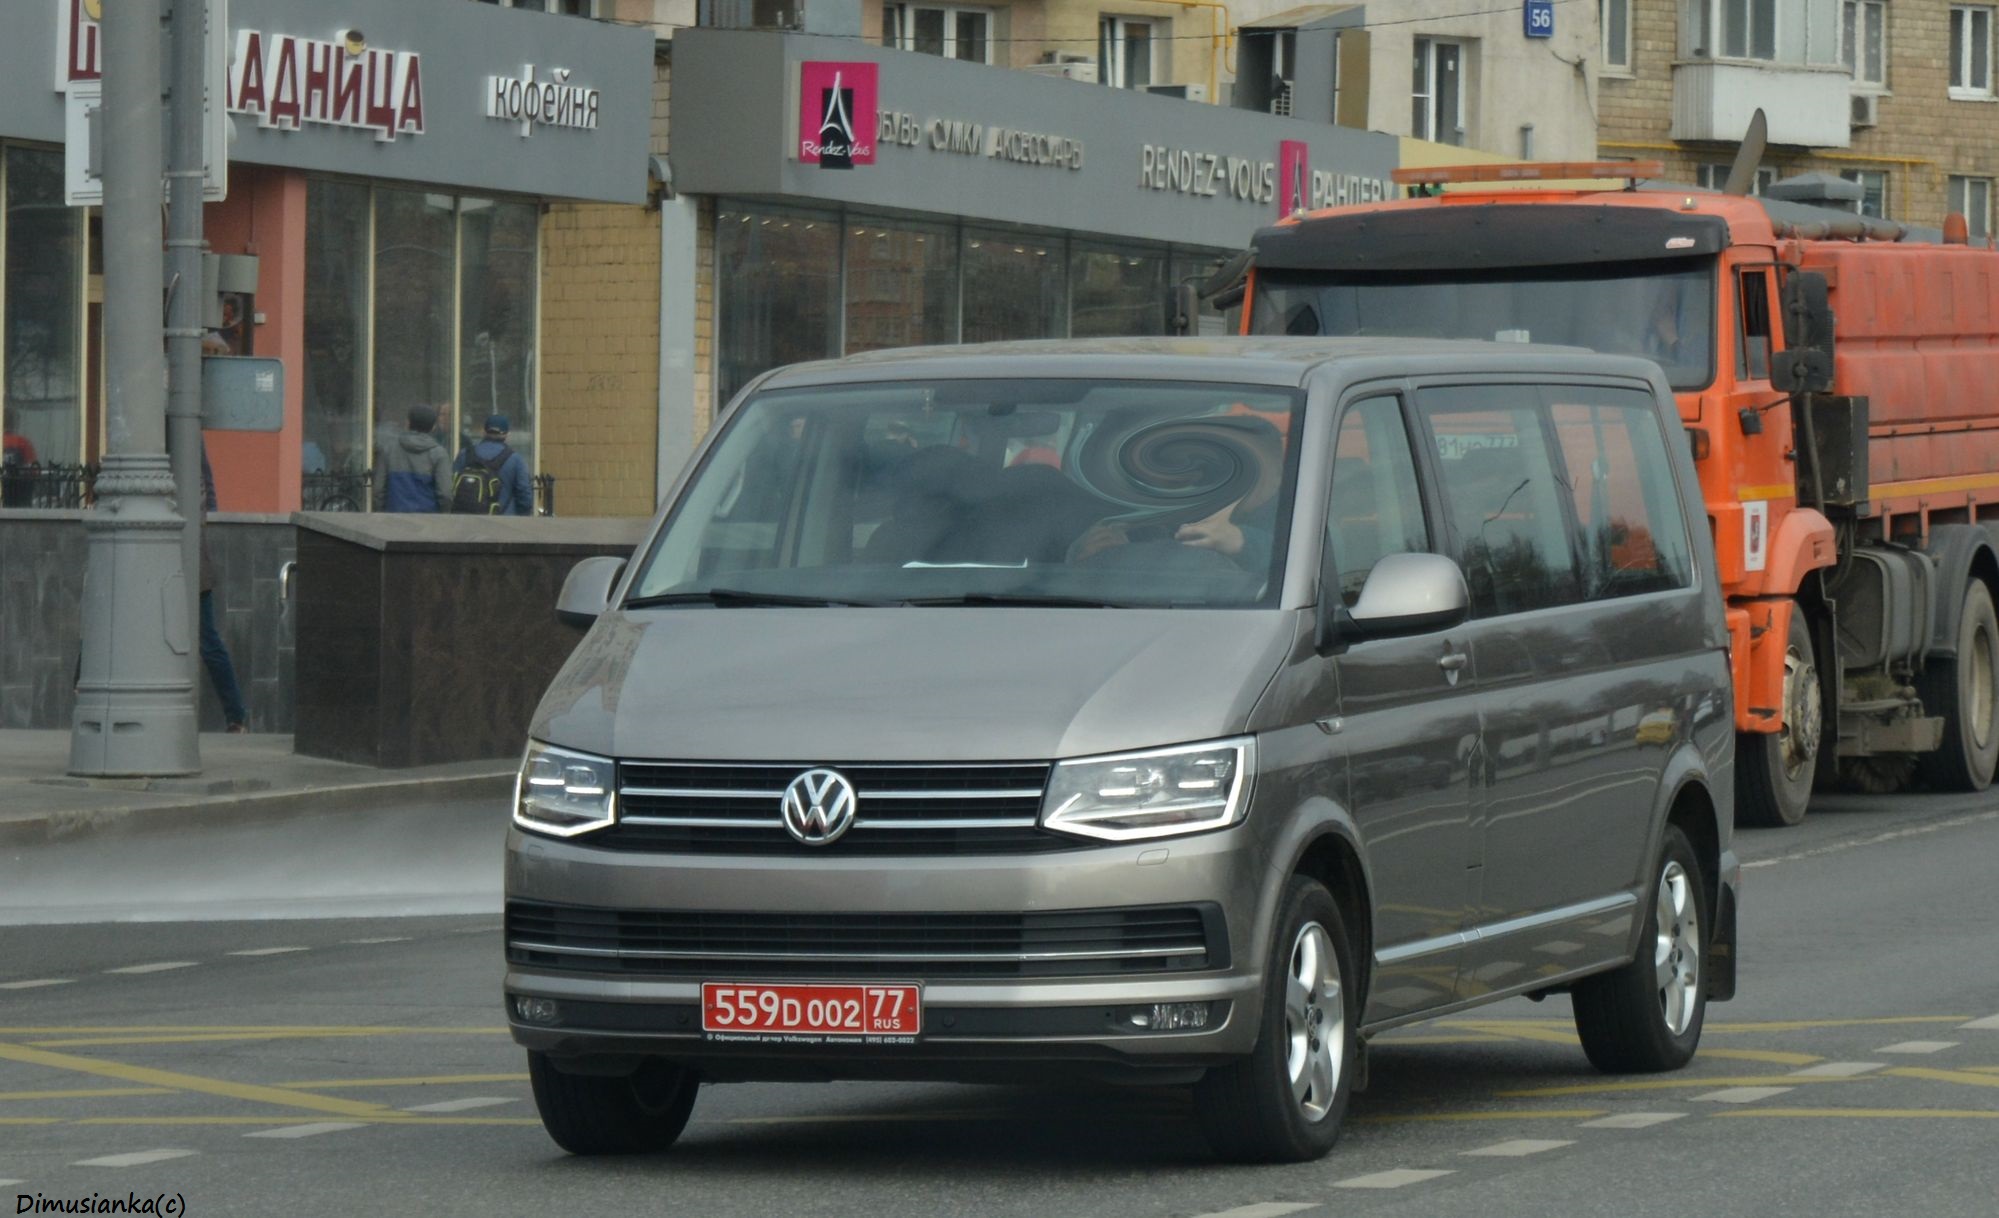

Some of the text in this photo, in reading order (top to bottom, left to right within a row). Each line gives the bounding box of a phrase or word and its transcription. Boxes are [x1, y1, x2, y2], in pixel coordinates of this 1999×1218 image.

[1531, 8, 1551, 28] 56
[494, 64, 600, 137] кофейня
[801, 140, 871, 158] Rendez-Vous
[932, 119, 982, 154] СУМКИ
[990, 127, 1081, 169] АКСЕССУАРЫ
[1141, 144, 1275, 203] RENDEZ-VOUS
[868, 989, 905, 1018] 77
[873, 1018, 901, 1030] RUS
